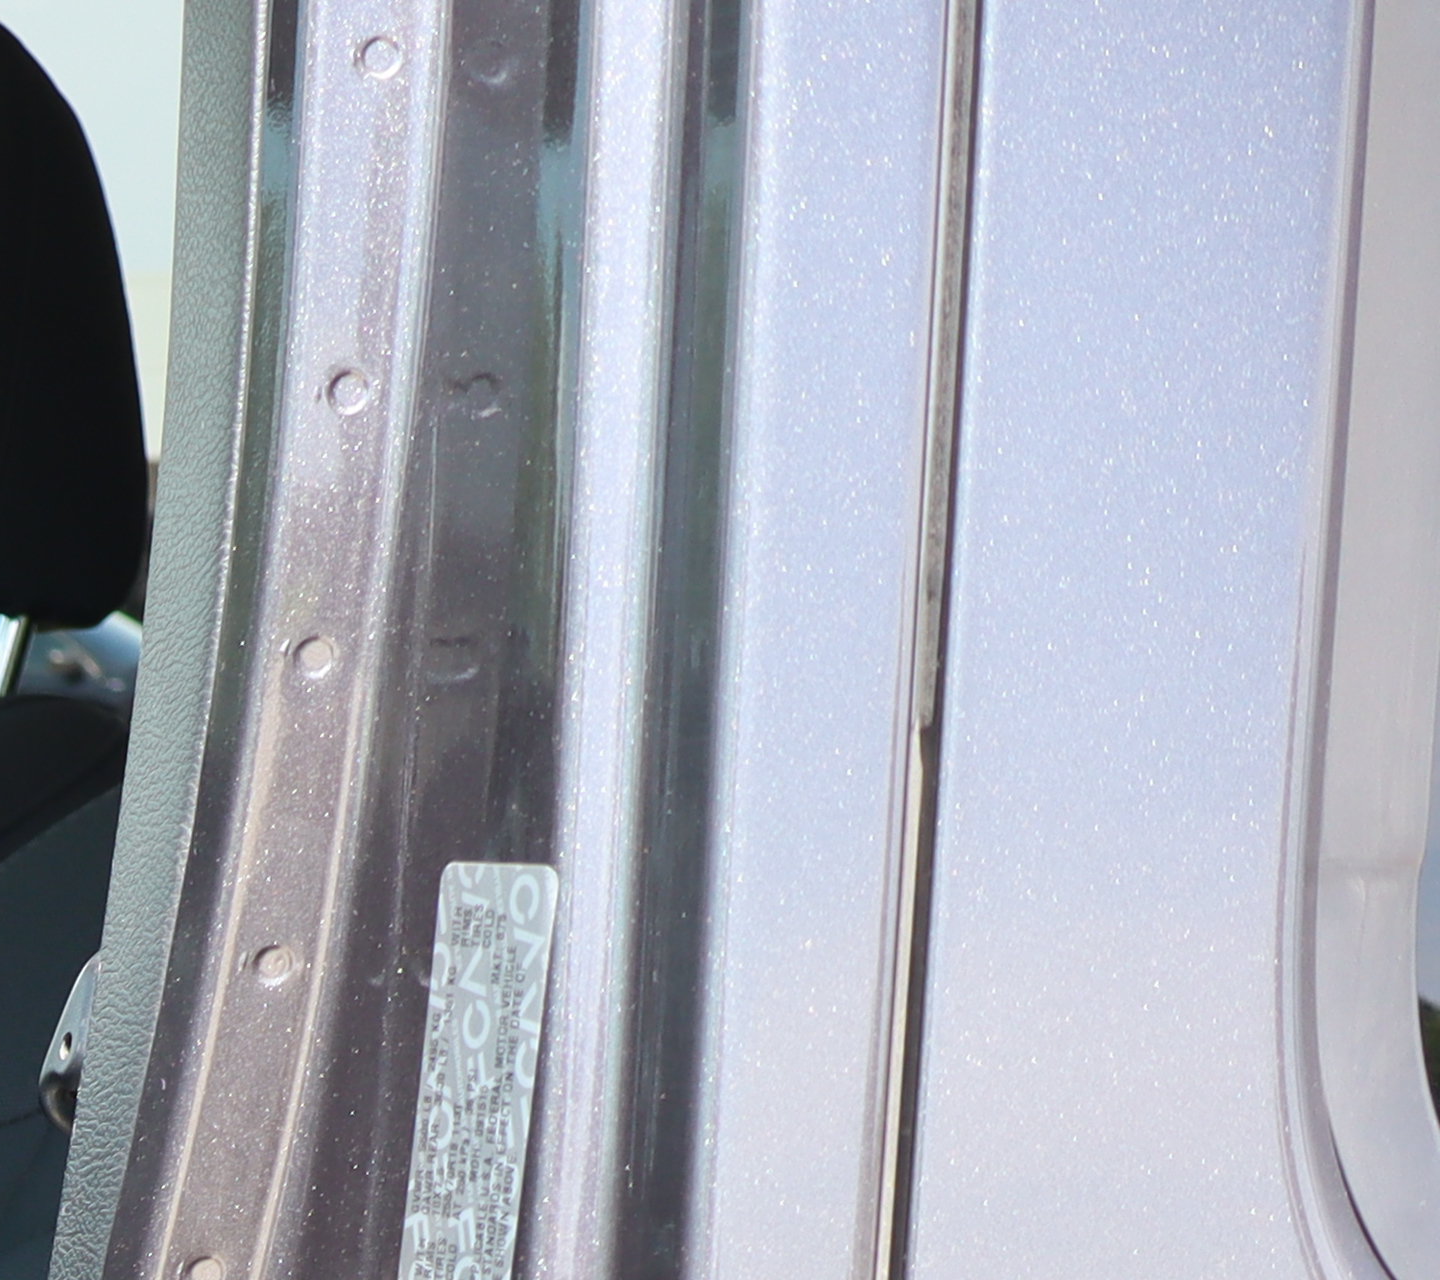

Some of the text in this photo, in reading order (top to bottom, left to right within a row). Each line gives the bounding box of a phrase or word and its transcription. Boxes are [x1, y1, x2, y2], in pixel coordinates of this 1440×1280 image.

[449, 905, 464, 947] WITH
[459, 907, 473, 947] RIMS
[469, 903, 484, 948] TIRES
[481, 907, 495, 949] COLD
[499, 944, 518, 1009] VEHICLE
[430, 1011, 441, 1032] KG
[508, 987, 524, 1030] DATE
[493, 1013, 510, 1069] MOTOR
[505, 1034, 519, 1065] THE
[420, 1168, 435, 1216] GAWR
[446, 964, 457, 986] KG
[501, 1070, 515, 1094] ON
[484, 1074, 503, 1145] FEDERAL
[494, 1098, 512, 1156] EFFECT
[492, 1160, 504, 1177] IN
[451, 1201, 462, 1220] AT
[480, 1181, 502, 1275] STANDARDS
[414, 1235, 427, 1278] WITH
[422, 1239, 436, 1279] RIMS
[433, 1236, 447, 1280] TIRES
[492, 1208, 510, 1267] SHOWN
